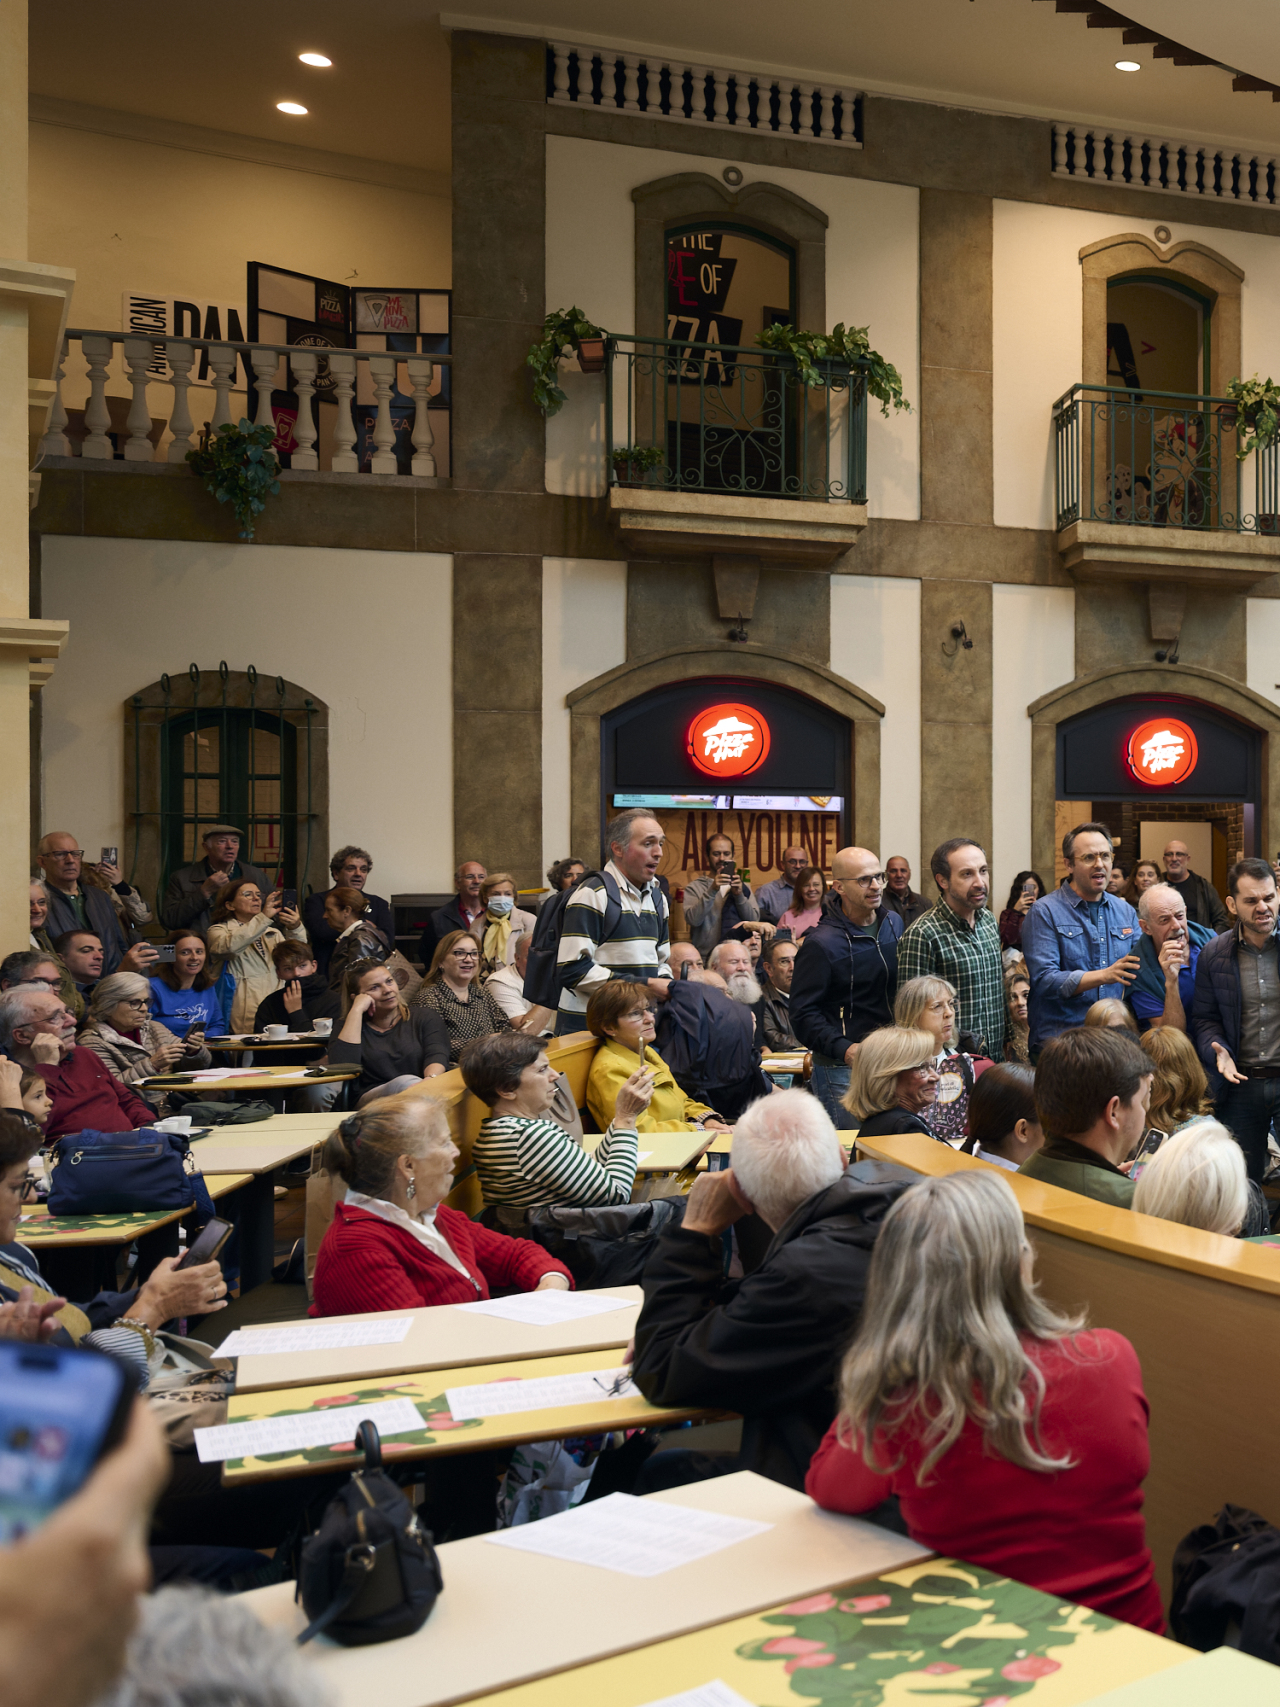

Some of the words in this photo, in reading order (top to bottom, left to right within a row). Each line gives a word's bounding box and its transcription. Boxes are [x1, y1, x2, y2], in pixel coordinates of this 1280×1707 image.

[700, 263, 723, 295] OF
[320, 298, 342, 313] PIZZA
[383, 314, 409, 330] PIZZA
[365, 418, 411, 431] PZA
[704, 732, 755, 757] Pizza
[712, 743, 750, 764] Hut
[736, 811, 794, 873] YOU
